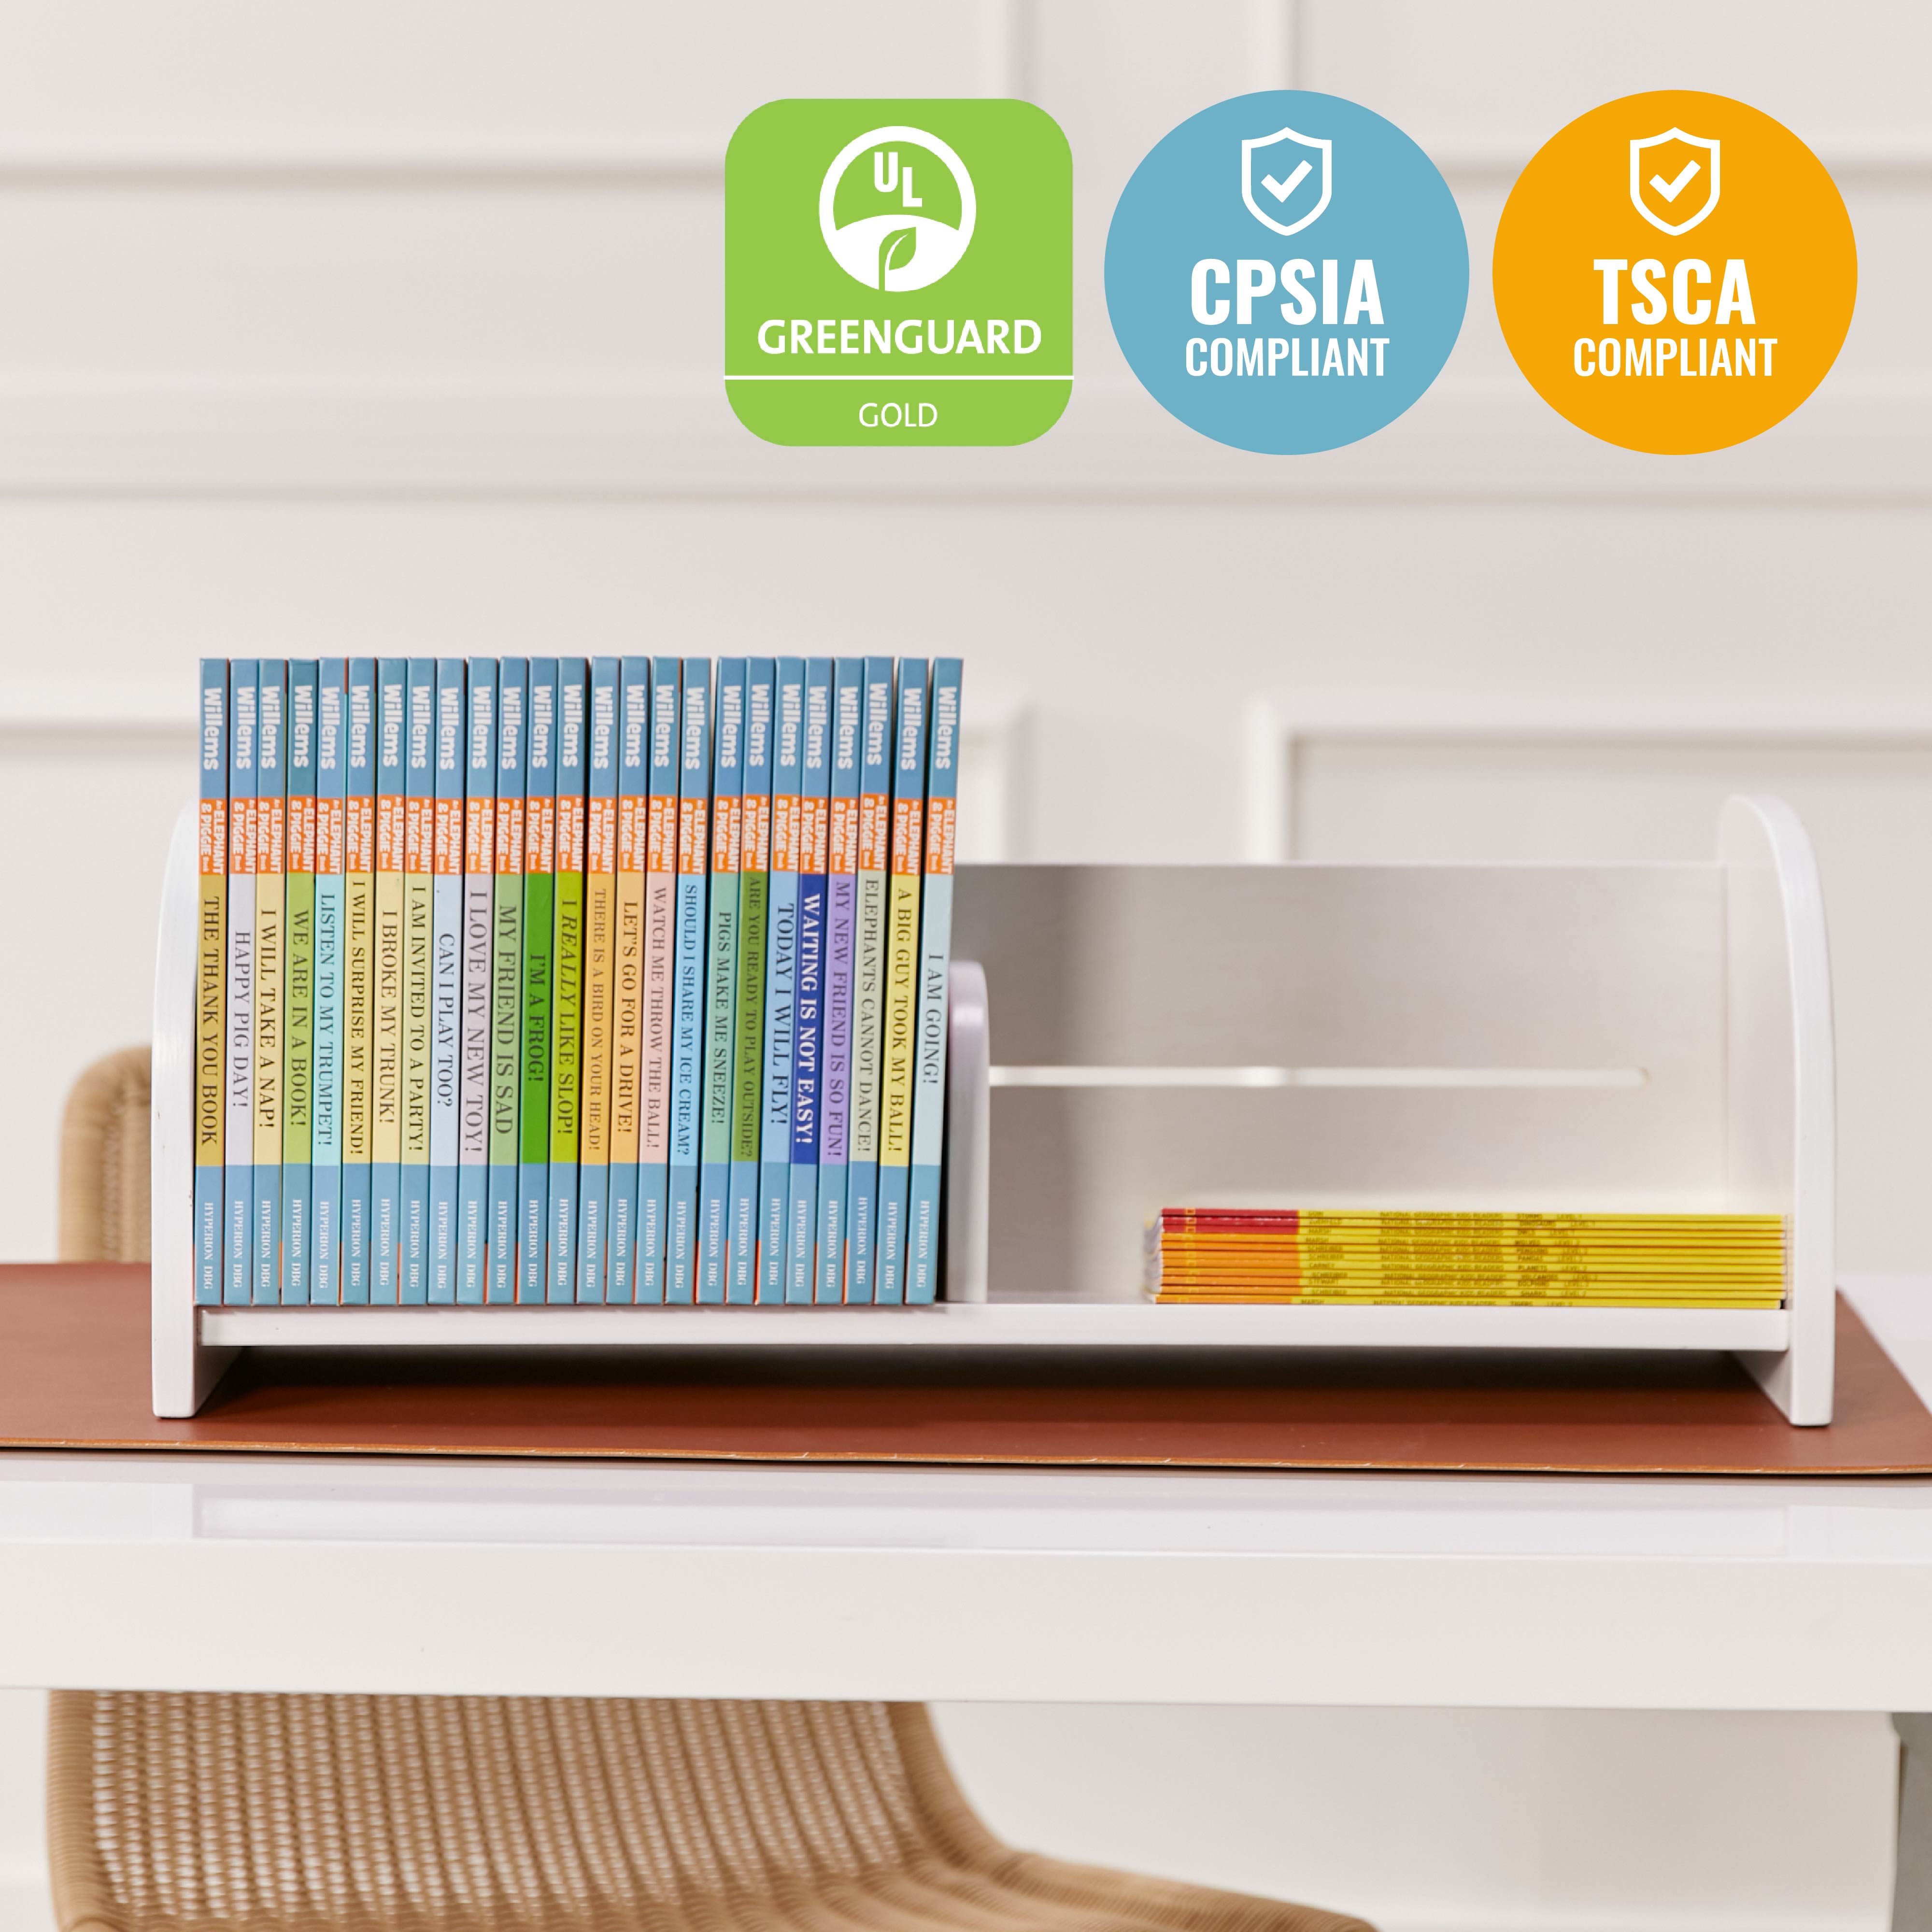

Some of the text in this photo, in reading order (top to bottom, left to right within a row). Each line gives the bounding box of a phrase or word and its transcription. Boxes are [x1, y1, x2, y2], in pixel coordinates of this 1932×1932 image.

[204, 688, 222, 769] Willems
[321, 687, 340, 769] Willems
[412, 686, 430, 767] Willems
[533, 686, 552, 767] Willems
[685, 688, 704, 769] Willems
[807, 686, 826, 768] Willems
[936, 687, 956, 768] Willems
[200, 815, 211, 855] PIGGIE
[201, 803, 211, 812] &
[213, 810, 224, 874] ELEPHANT
[929, 814, 942, 853] PIGGIE
[932, 802, 942, 811] &
[941, 810, 954, 874] ELEPHANT
[352, 894, 365, 940] WILL
[412, 900, 426, 928] AM
[469, 908, 487, 972] LOVE
[684, 885, 697, 950] SHOULD
[776, 903, 794, 980] TODAY
[261, 925, 276, 980] WILL
[381, 925, 398, 997] BROKE
[411, 937, 426, 1017] INVITED
[439, 934, 455, 975] CAN
[560, 914, 577, 1007] REALLY
[927, 969, 942, 999] AM
[201, 896, 219, 1145] THE THANK YOU BOOK
[233, 932, 250, 1107] HAPPY PIG DAY!
[260, 988, 275, 1047] TAKE
[291, 910, 309, 1125] WE ARE IN A BOOK!
[318, 895, 335, 1145] LISTEN TO MY TRUMPET!
[351, 948, 365, 1038] SURPRISE
[381, 1006, 396, 1036] MY
[439, 997, 454, 1047] PLAY
[468, 982, 486, 1018] MY
[495, 906, 516, 1134] MY FRIEND IS SAD
[526, 954, 546, 1081] I'M A FROG!
[589, 889, 606, 1150] THERE IS A BIRD ON YOUR HEAD!
[618, 902, 638, 1132] LET'S GO FOR A DRIVE!
[647, 888, 667, 1147] WATCH ME THROW THE BALL!
[682, 966, 695, 1021] SHARE
[712, 912, 731, 1123] PIGS MAKE ME SNEEZE!
[740, 877, 761, 1156] ARE YOU READY TO PLAY OUTSIDE?
[796, 893, 822, 1143] WAITING IS NOT EASY!
[827, 882, 850, 1155] MY NEW FRIEND IS SO FUN!
[858, 880, 879, 1151] ELEPHANTS CANNOT DANCE!
[888, 889, 912, 1151] A BIG GUY TOOK MY BALL!
[260, 1056, 275, 1068] A
[351, 1047, 364, 1071] MY
[410, 1025, 425, 1051] TO
[410, 1059, 424, 1070] A
[467, 1028, 484, 1086] NEW
[559, 1012, 575, 1065] LIKE
[680, 1057, 692, 1083] ICE
[681, 1027, 693, 1050] MY
[773, 1005, 791, 1066] WILL
[923, 1009, 940, 1083] GOING!
[259, 1078, 275, 1127] NAP!
[351, 1080, 364, 1153] FRIEND!
[380, 1043, 395, 1122] TRUNK!
[409, 1079, 424, 1150] PARTY!
[437, 1055, 453, 1107] TOO?
[557, 1073, 574, 1134] SLOP!
[771, 1076, 789, 1124] FLY!
[465, 1095, 483, 1151] TOY!
[677, 1089, 691, 1155] CREAM?
[204, 1203, 213, 1289] HYPERION DBG
[529, 1200, 538, 1286] HYPERION DBG
[617, 1200, 627, 1285] HYPERION DBG
[918, 1201, 929, 1287] HYPERION DBG
